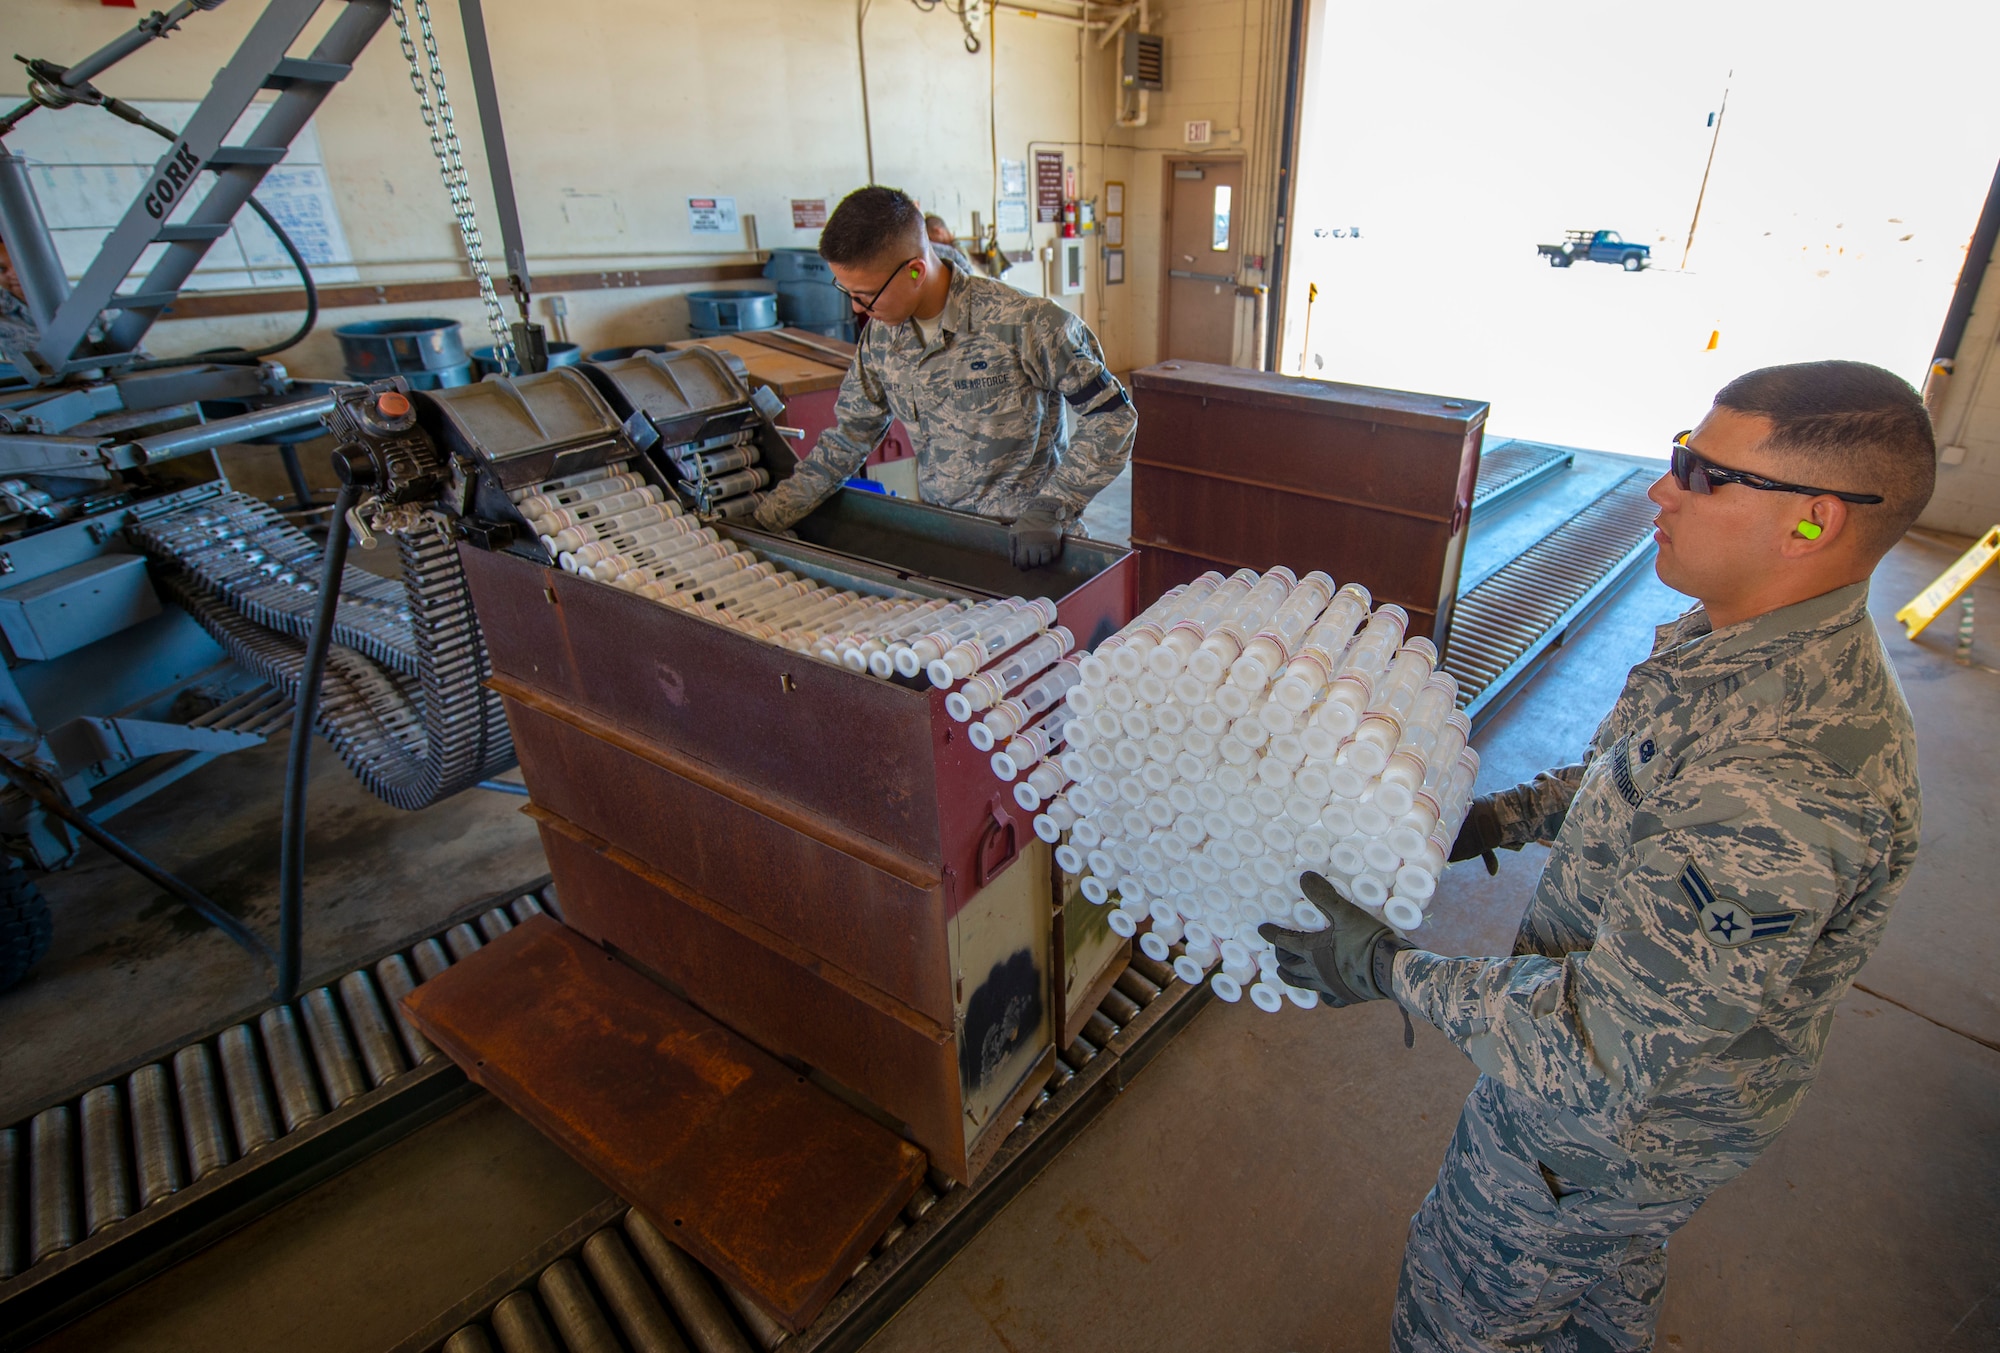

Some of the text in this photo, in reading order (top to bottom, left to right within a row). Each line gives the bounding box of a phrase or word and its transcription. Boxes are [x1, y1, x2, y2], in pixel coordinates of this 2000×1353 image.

[1188, 122, 1207, 142] EXIT
[143, 139, 201, 221] GORK
[981, 372, 1010, 388] FORCE
